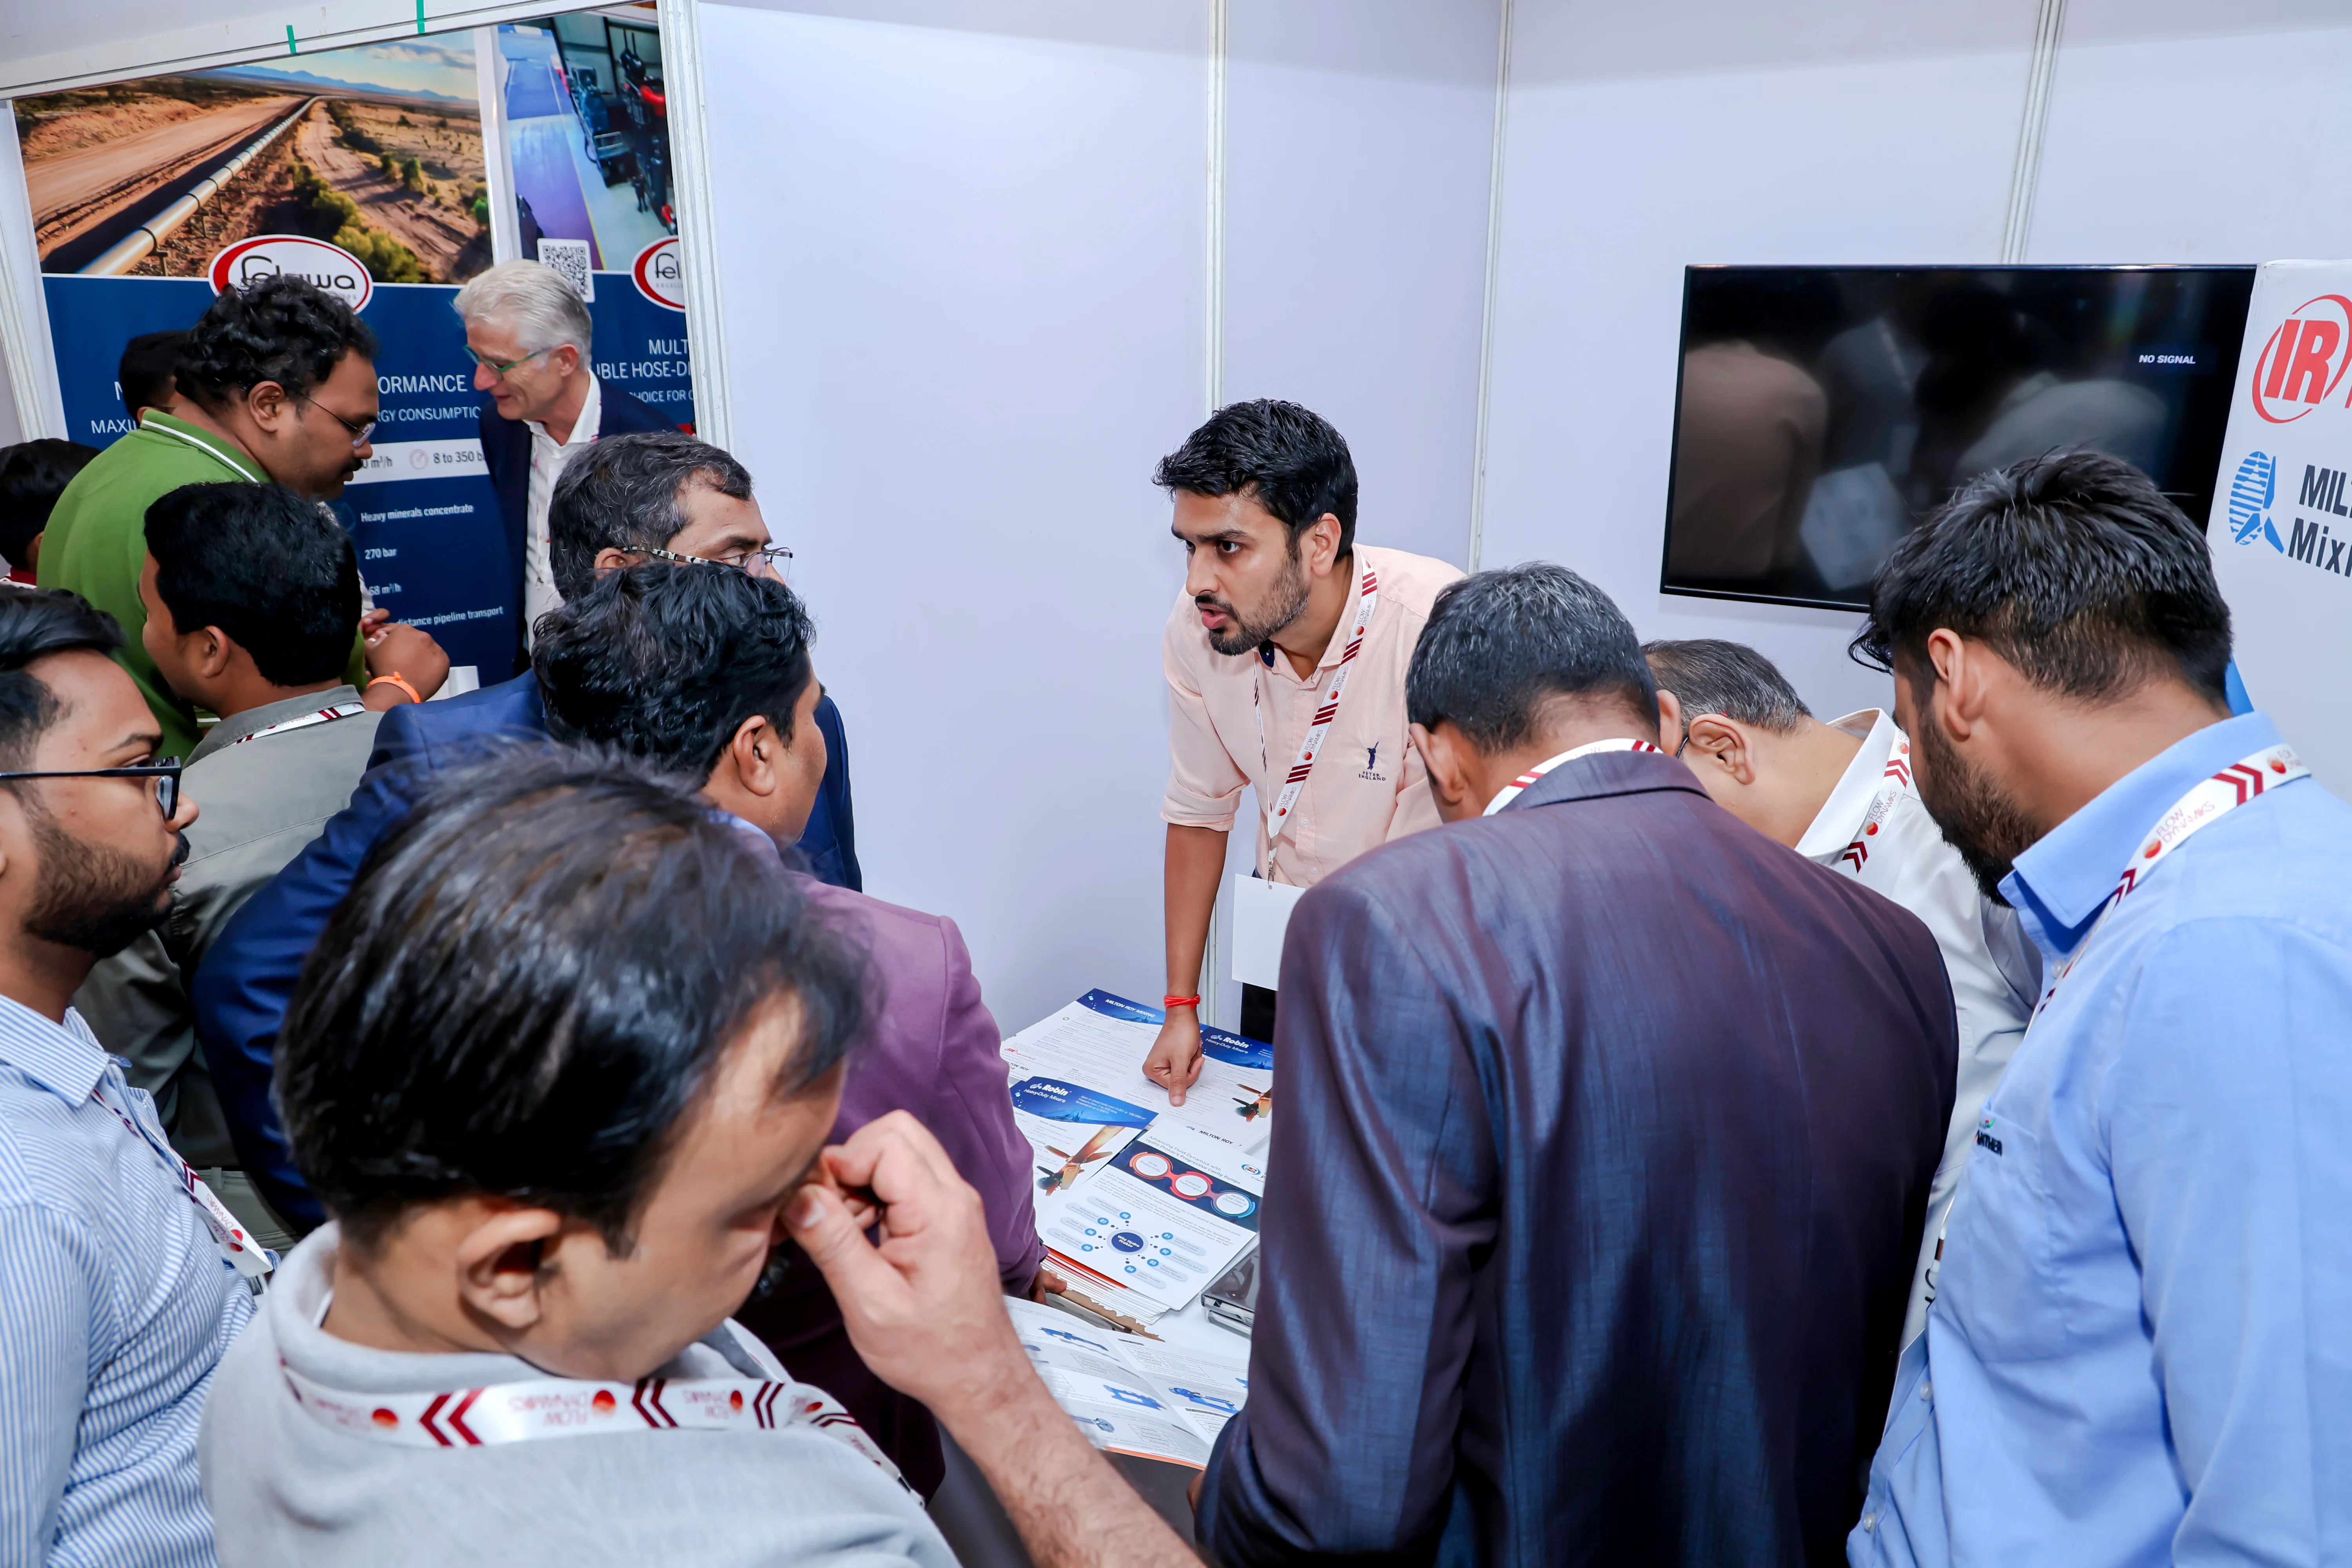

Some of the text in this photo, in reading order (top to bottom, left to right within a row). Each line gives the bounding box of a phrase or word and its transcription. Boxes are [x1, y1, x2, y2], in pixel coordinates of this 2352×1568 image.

[2139, 355, 2196, 364] NO SIGNAL
[2263, 319, 2340, 404] IR
[377, 375, 468, 394] ORMANCE
[629, 390, 686, 402] HOICE FOR
[377, 410, 396, 422] RGY
[433, 453, 440, 463] 8
[442, 453, 452, 463] to
[455, 451, 474, 463] 350
[2299, 464, 2352, 518] MIL
[361, 504, 474, 523] Heavy minerals concentrate
[365, 548, 397, 560] 270 bar
[434, 612, 466, 626] pipeline
[467, 606, 504, 619] transport
[1332, 676, 1341, 690] FLOW
[1305, 737, 1314, 751] FLOW
[1279, 793, 1288, 807] FLOW
[1868, 800, 1884, 820] FLOW
[2156, 808, 2184, 837] FLOW
[1105, 999, 1125, 1008] MILTON
[1135, 1009, 1156, 1018] MIXING
[1205, 1038, 1232, 1049] Heavy-Duty
[1223, 1037, 1250, 1049] Robin
[1024, 1089, 1066, 1103] Heavy-Duty Mixers
[1042, 1084, 1069, 1096] Robin
[1199, 1130, 1220, 1141] MILTON
[1149, 1136, 1174, 1149] Advancing
[1186, 1153, 1210, 1166] Dynamics
[1140, 1160, 1161, 1172] Productivity
[1145, 1138, 1160, 1147] Hydro
[1180, 1155, 1207, 1169] Progressive
[1208, 1168, 1223, 1177] Cavity
[1223, 1175, 1241, 1185] Pumps
[1179, 1180, 1203, 1193] Performance
[1185, 1179, 1201, 1189] Enhance
[1223, 1198, 1243, 1209] Ownership
[1118, 1240, 1134, 1248] Prokav
[1127, 1240, 1140, 1248] Hydro
